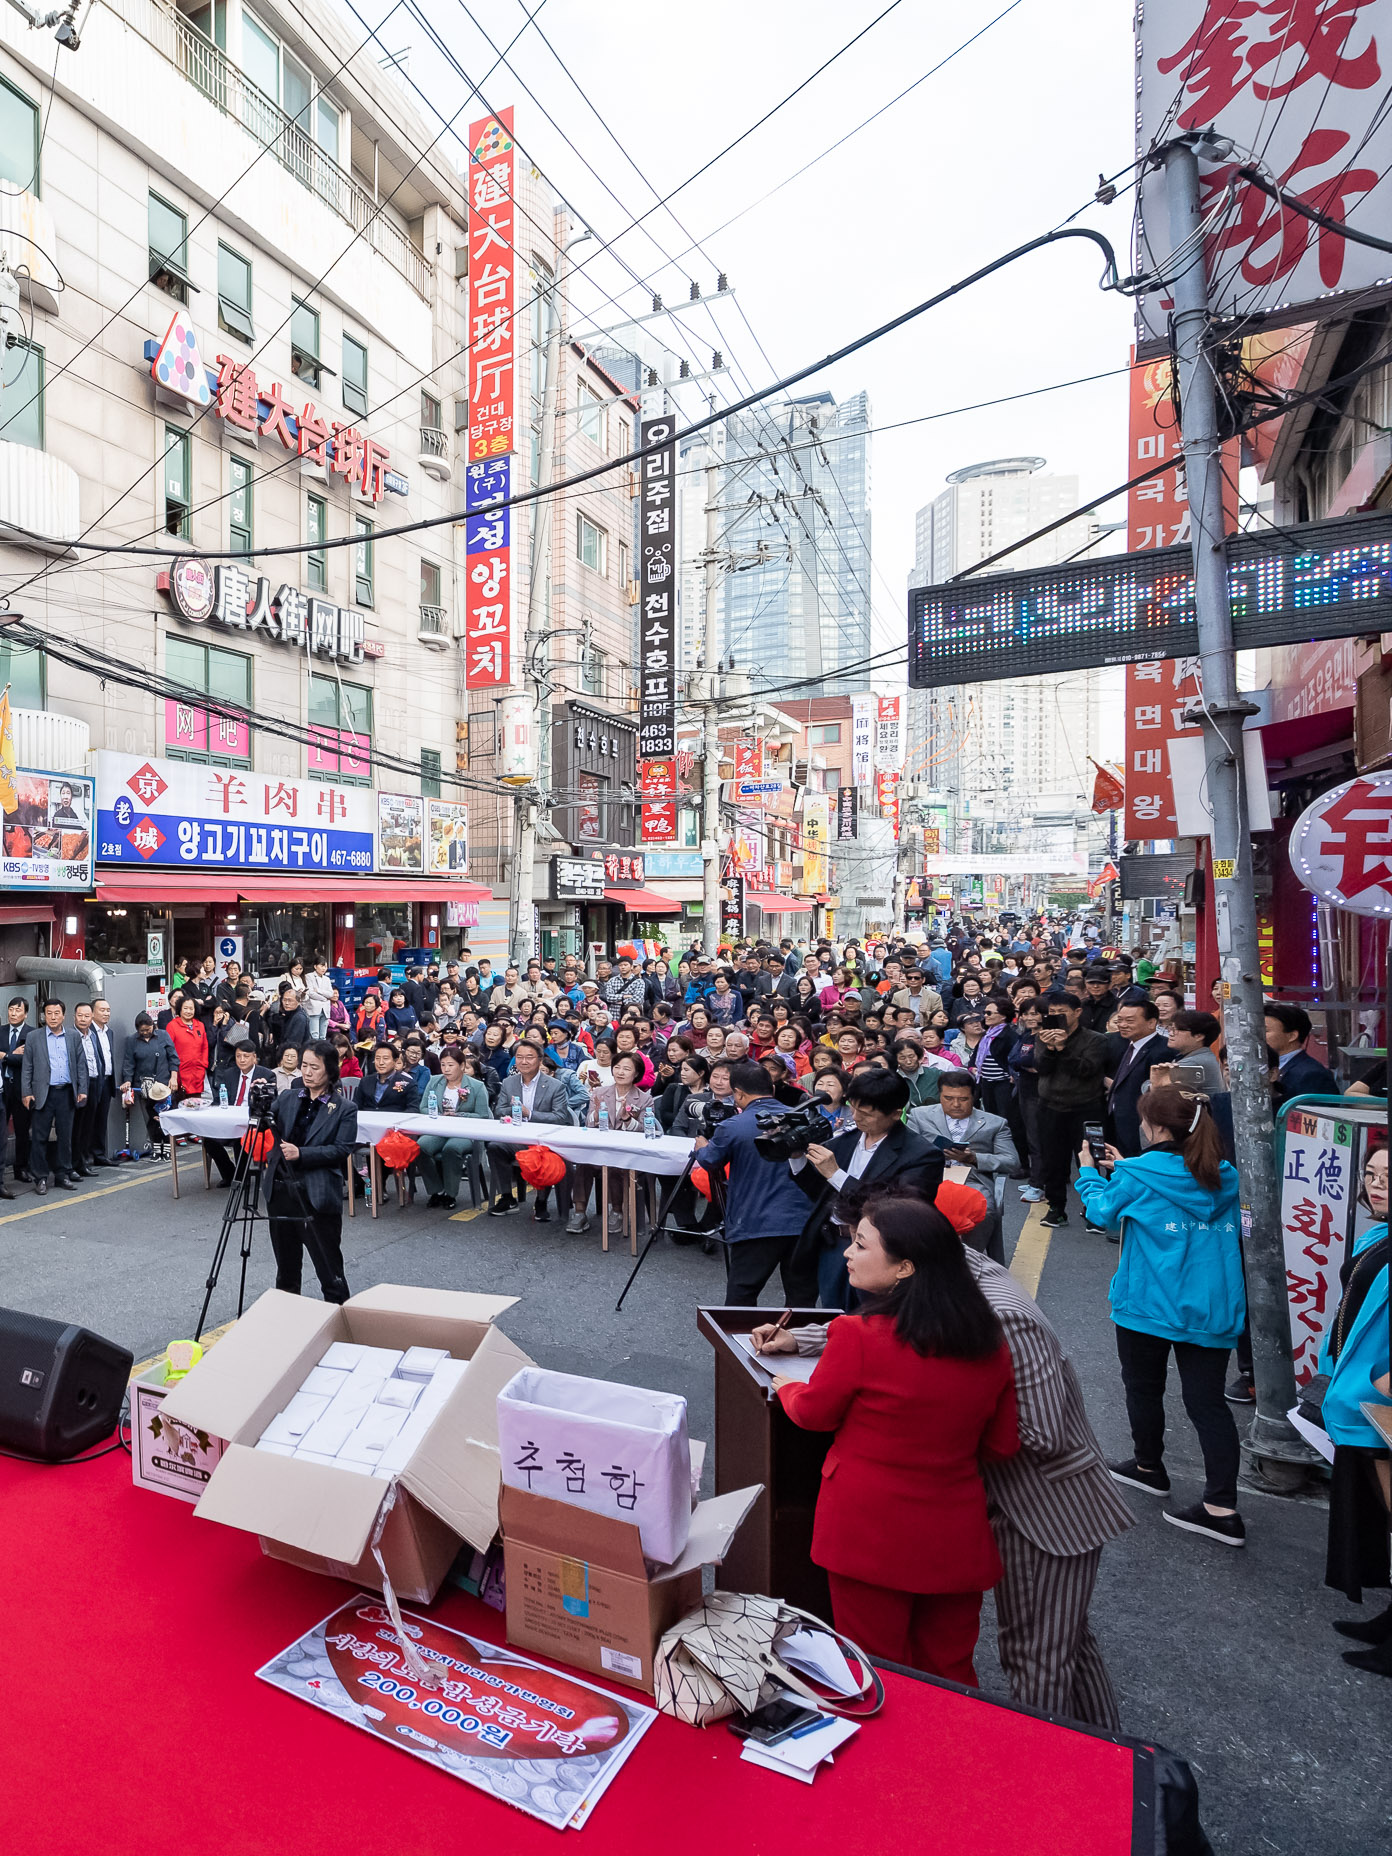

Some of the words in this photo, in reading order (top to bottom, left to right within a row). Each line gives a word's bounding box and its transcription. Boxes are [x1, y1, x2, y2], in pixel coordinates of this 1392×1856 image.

[472, 163, 512, 403] 建大台球厅
[215, 353, 392, 502] 建大台球厅
[470, 417, 513, 439] 당구장
[476, 407, 505, 421] 건대
[474, 434, 509, 457] 3층
[468, 462, 509, 478] 원조
[473, 474, 506, 494] (구)
[215, 564, 365, 665] 唐人街网吧
[469, 557, 507, 681] 양꼬치
[645, 590, 671, 700] 천수호프
[641, 723, 674, 738] 463-
[641, 738, 673, 753] 1833
[205, 772, 347, 824] 羊肉串
[3, 861, 21, 873] KBS
[101, 842, 123, 856] 2호점
[177, 820, 328, 867] 양고기꼬치구이
[330, 849, 372, 867] 467-6880
[1284, 1148, 1346, 1201] 正德
[513, 1440, 646, 1511] 추첨함
[357, 1670, 514, 1750] 200,000원
